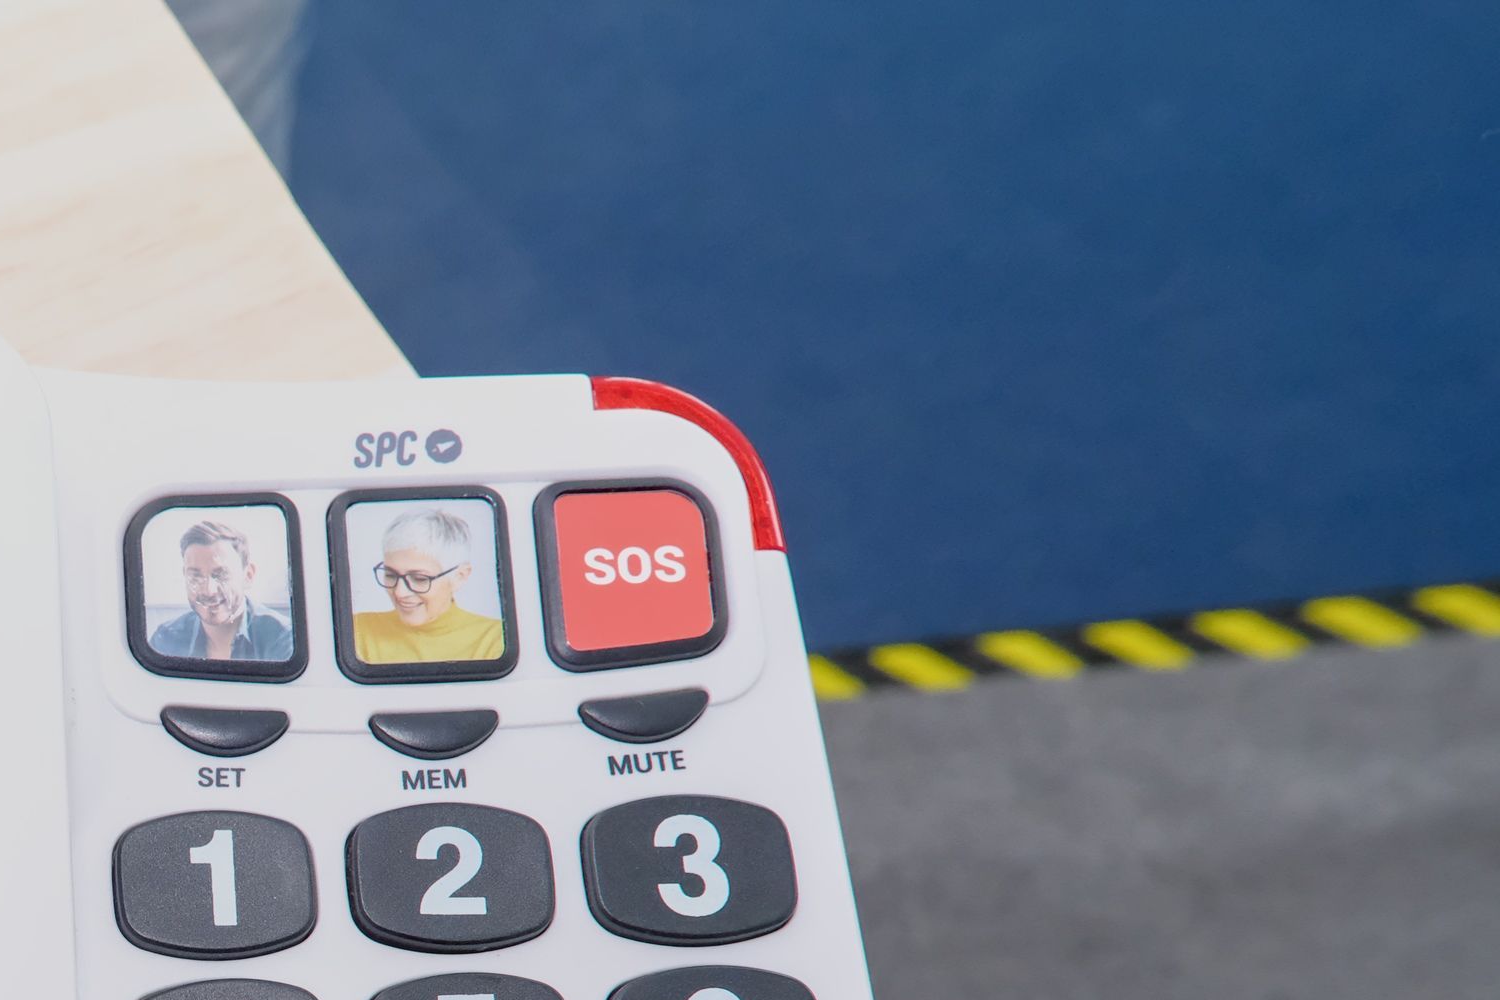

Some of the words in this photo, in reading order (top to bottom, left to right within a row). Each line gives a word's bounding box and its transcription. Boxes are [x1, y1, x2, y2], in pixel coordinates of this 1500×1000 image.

[353, 430, 418, 469] SPC
[583, 544, 687, 586] SOS
[197, 766, 246, 788] SET
[401, 768, 467, 791] MEM
[607, 749, 687, 776] MUTE
[189, 829, 238, 927] 1
[415, 825, 488, 916] 2
[653, 814, 730, 918] 3
